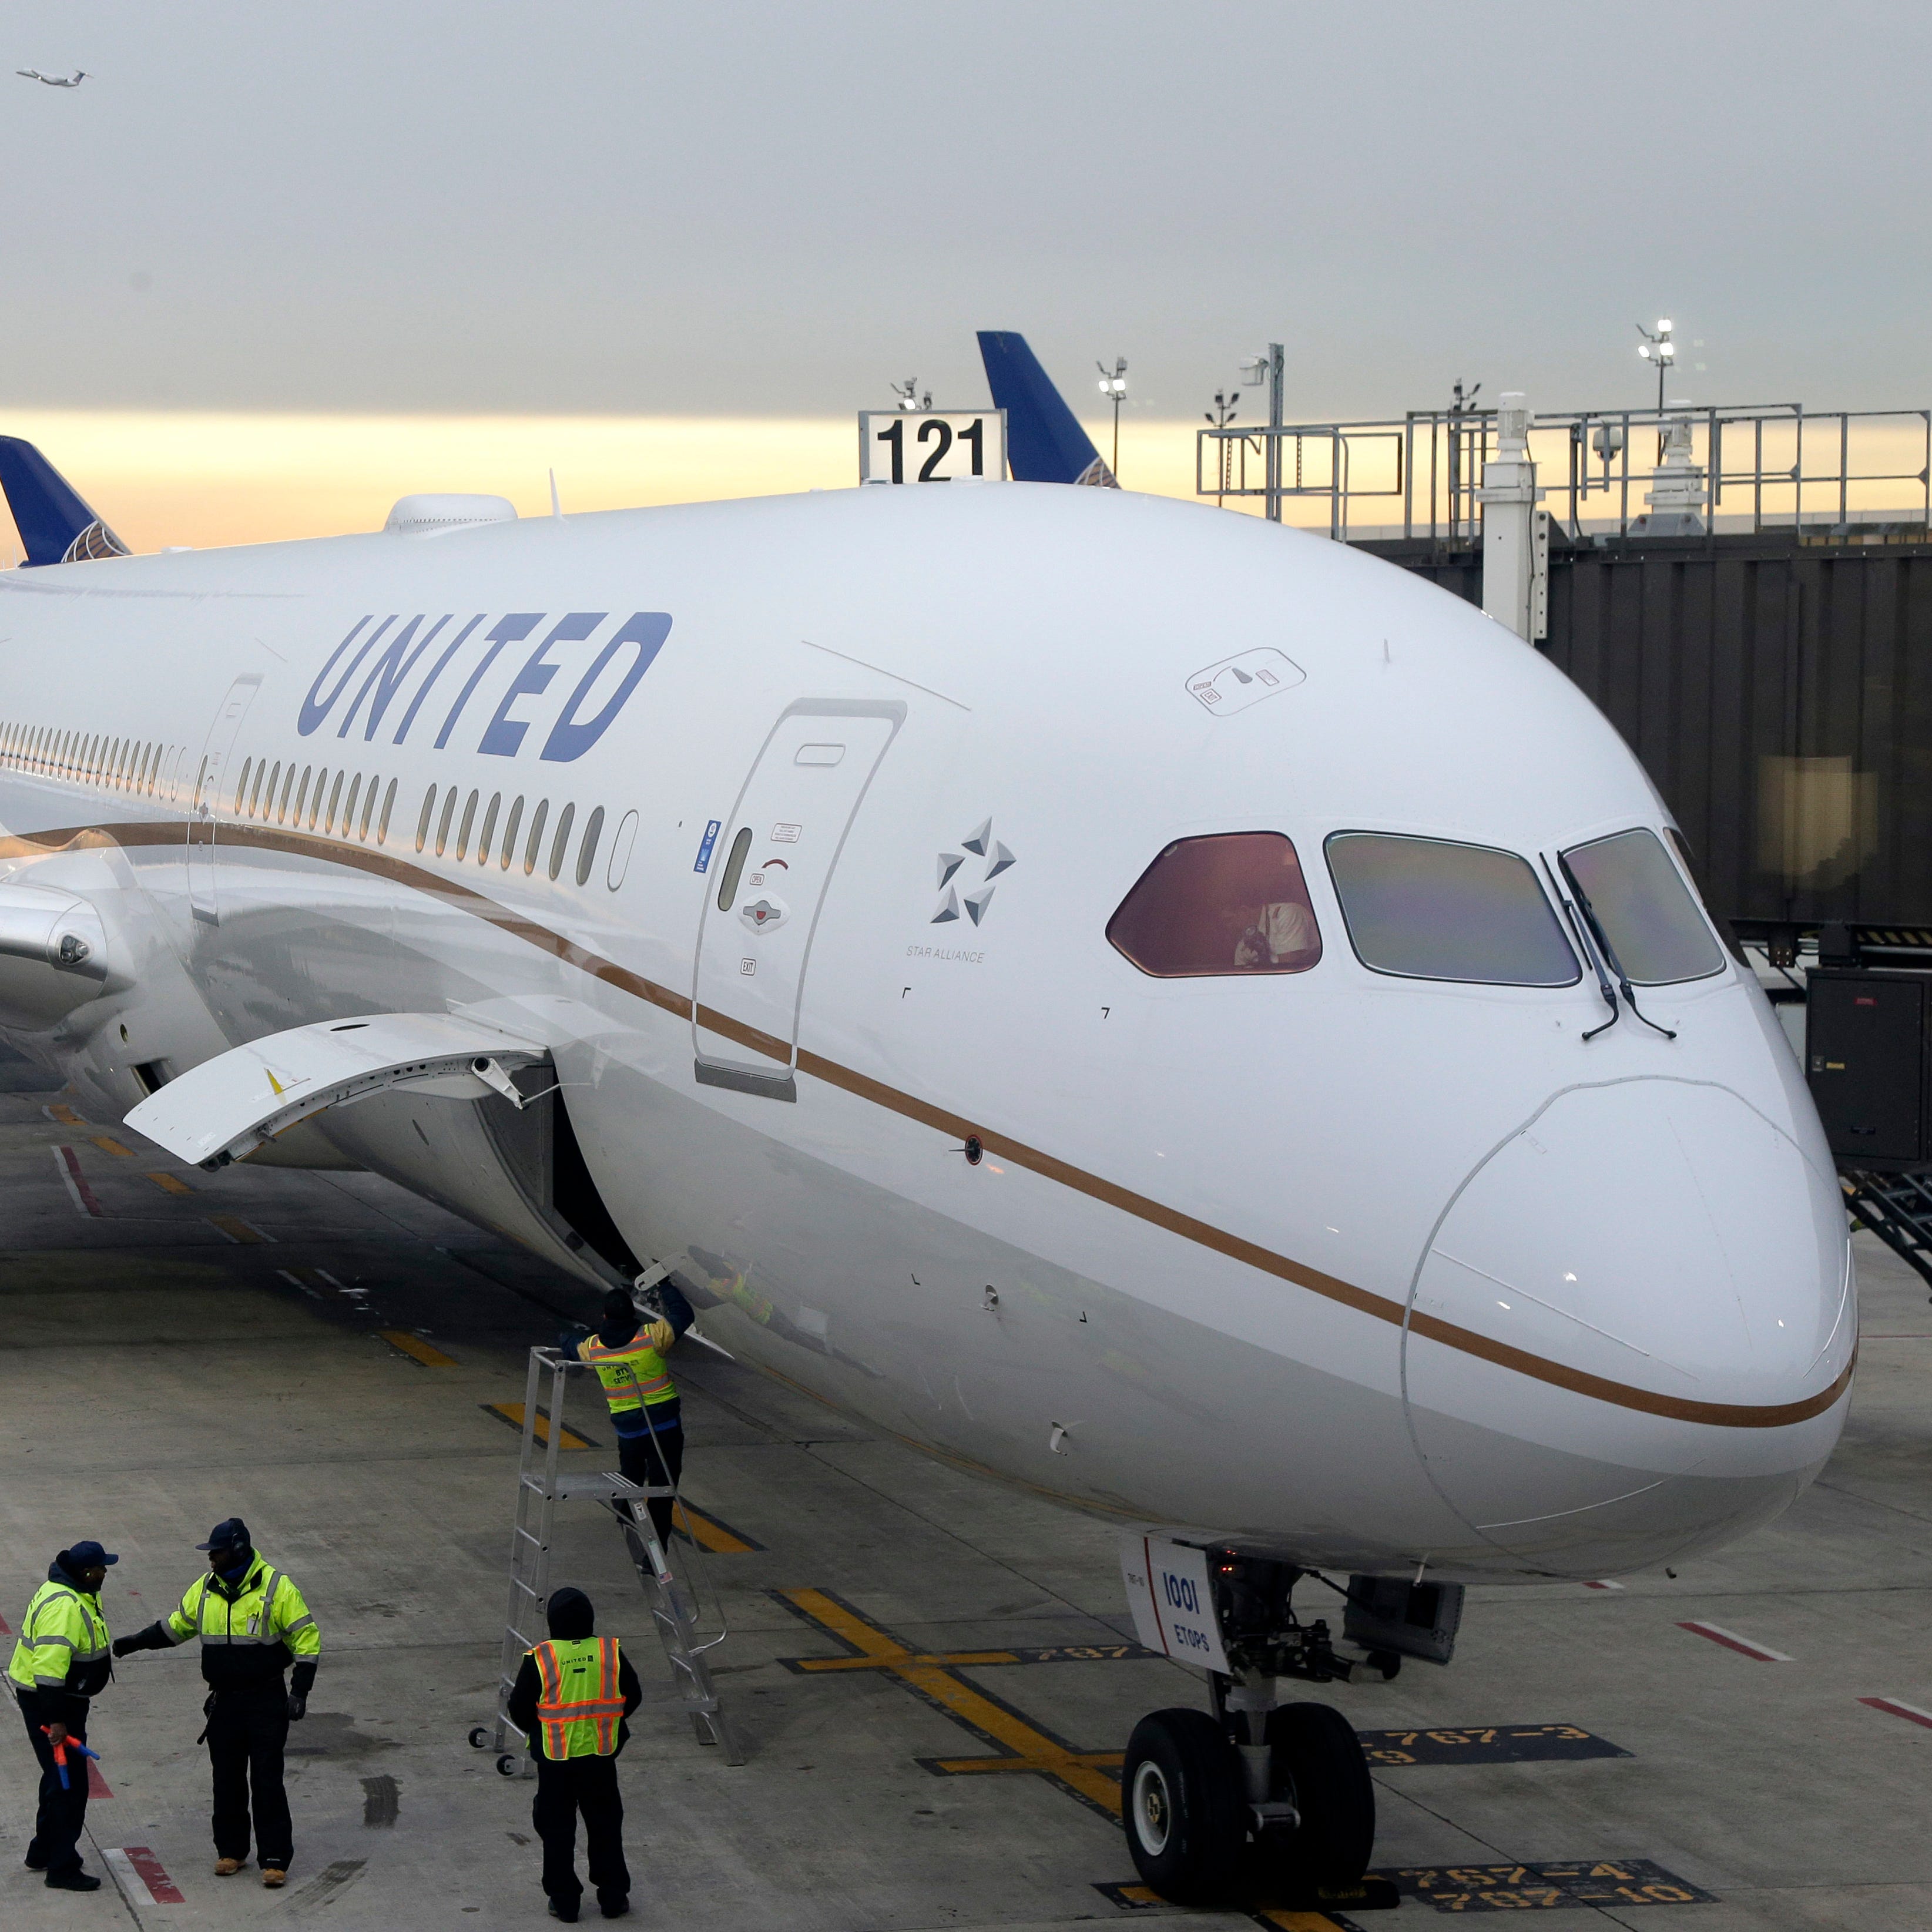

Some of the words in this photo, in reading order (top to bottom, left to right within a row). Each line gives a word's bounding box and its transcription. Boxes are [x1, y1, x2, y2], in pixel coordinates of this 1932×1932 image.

[877, 418, 983, 484] 121
[297, 612, 673, 763] UNITED
[907, 945, 932, 958] STAR
[933, 948, 984, 963] ALLIANCE
[743, 961, 754, 972] EXIT
[1163, 1572, 1200, 1614] 1001
[1174, 1624, 1210, 1652] ETOPS
[562, 1657, 586, 1665] UNITED
[1384, 1726, 1589, 1746] 767-3
